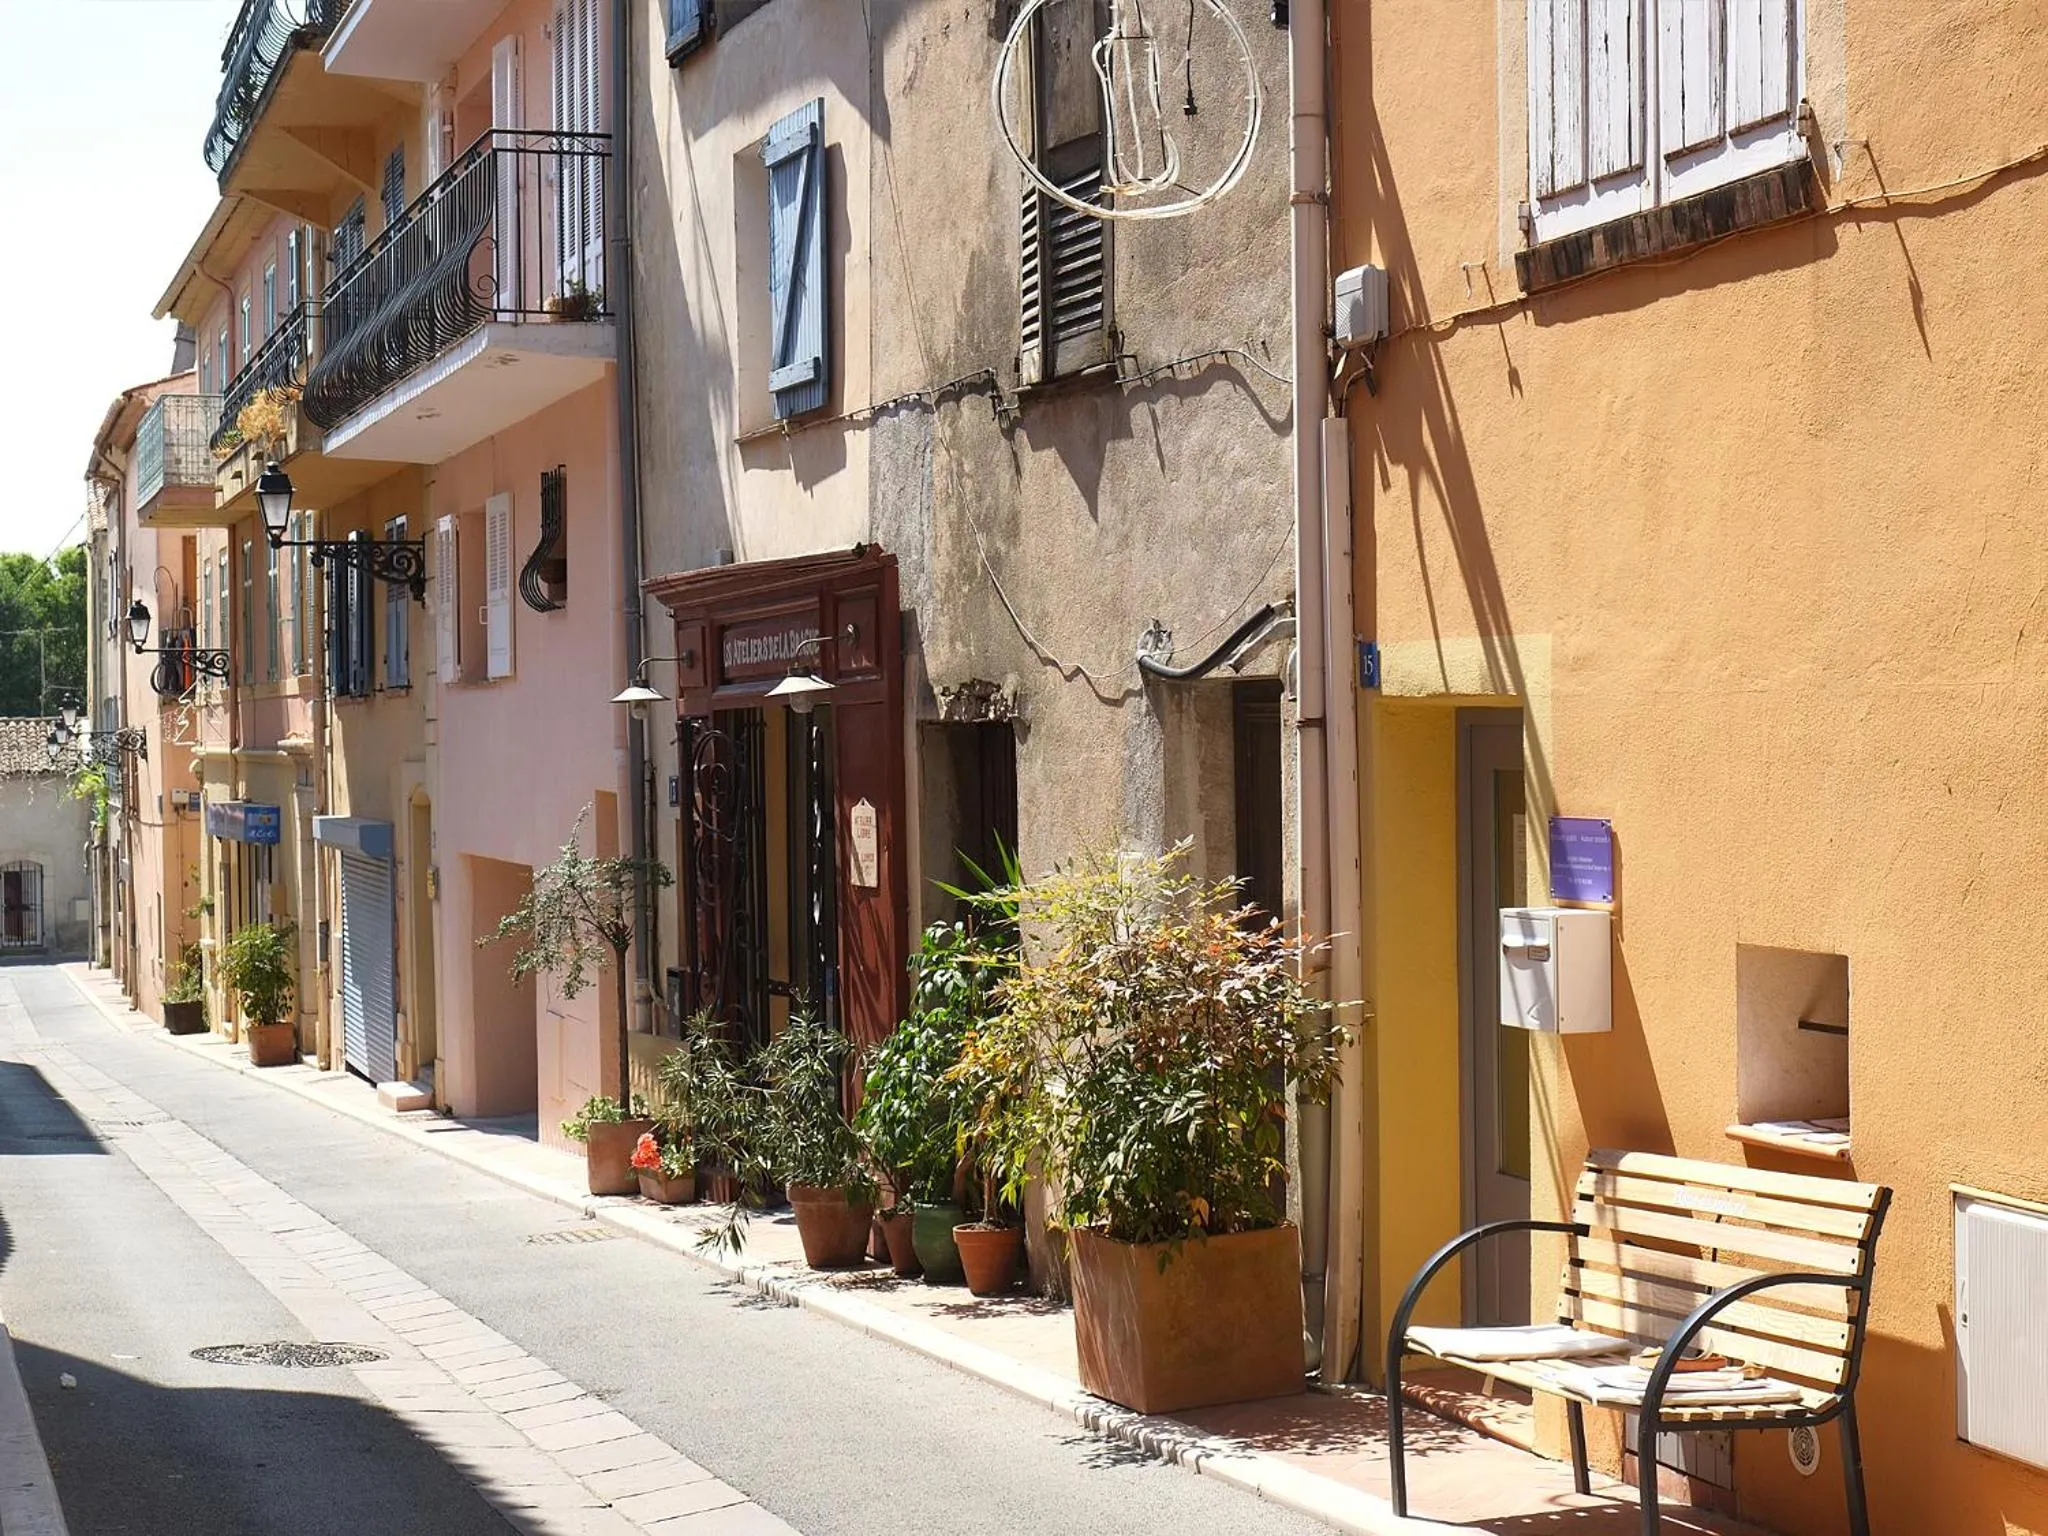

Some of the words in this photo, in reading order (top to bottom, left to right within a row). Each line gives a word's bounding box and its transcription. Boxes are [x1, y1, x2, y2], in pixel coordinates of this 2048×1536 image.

[733, 636, 768, 665] ATELIERS
[768, 635, 779, 660] DE
[779, 632, 789, 659] LA
[1363, 654, 1374, 676] 15
